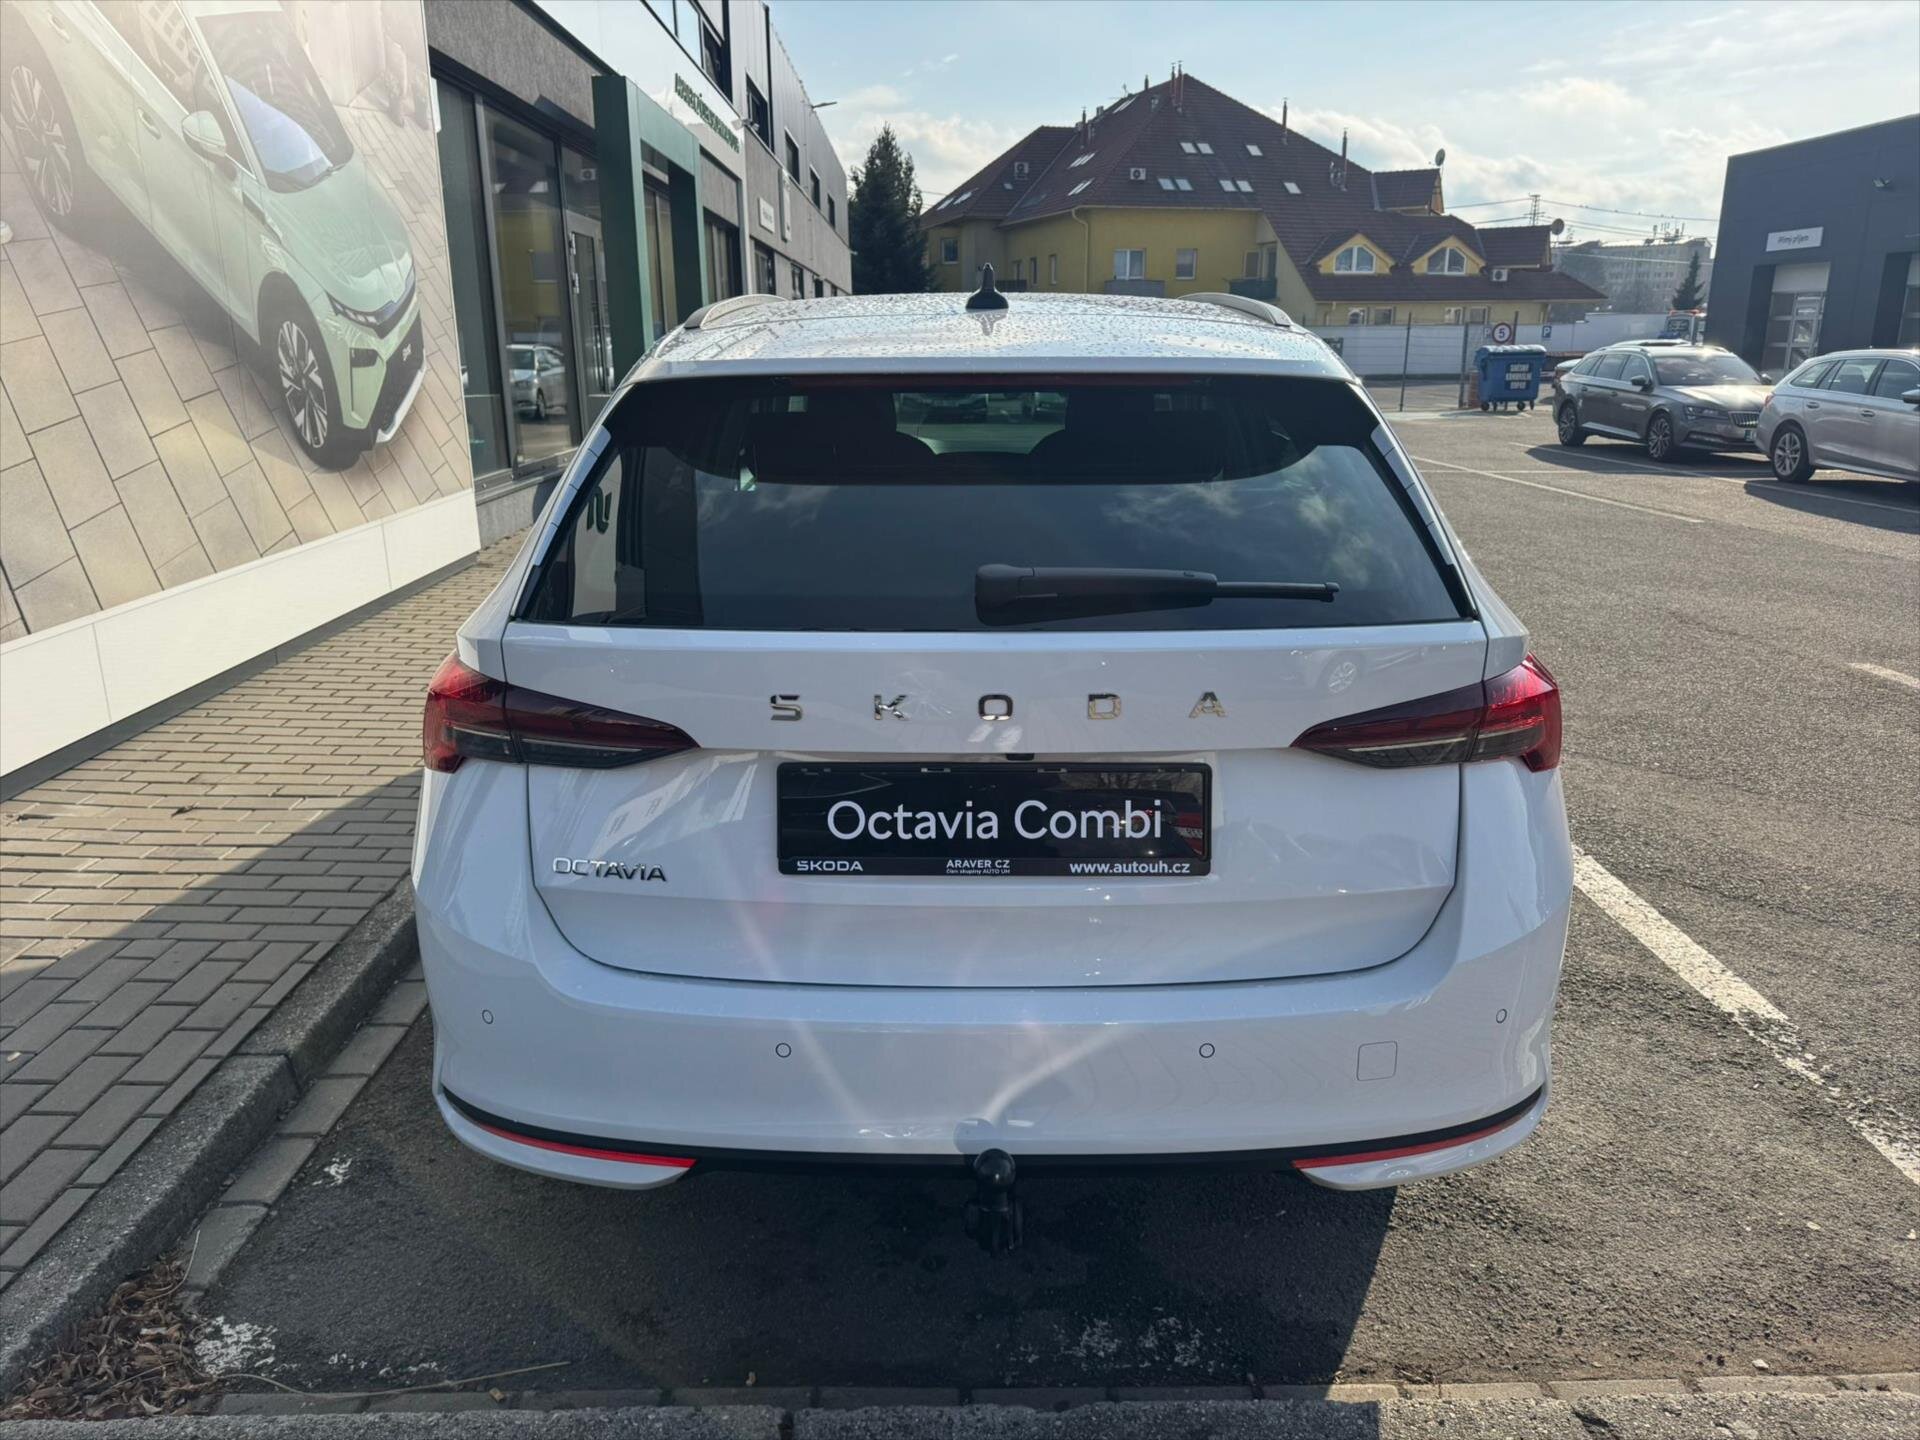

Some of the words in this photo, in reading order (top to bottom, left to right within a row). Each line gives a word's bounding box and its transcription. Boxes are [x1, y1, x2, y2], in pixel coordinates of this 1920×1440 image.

[1498, 328, 1505, 338] 5
[1543, 327, 1550, 337] P
[827, 800, 998, 840] Octavia
[1014, 799, 1161, 840] Combi
[552, 857, 667, 881] OCTAVIA
[946, 859, 992, 868] ARAVER
[994, 859, 1010, 869] CZ
[1069, 860, 1191, 874] www.autouh.cz
